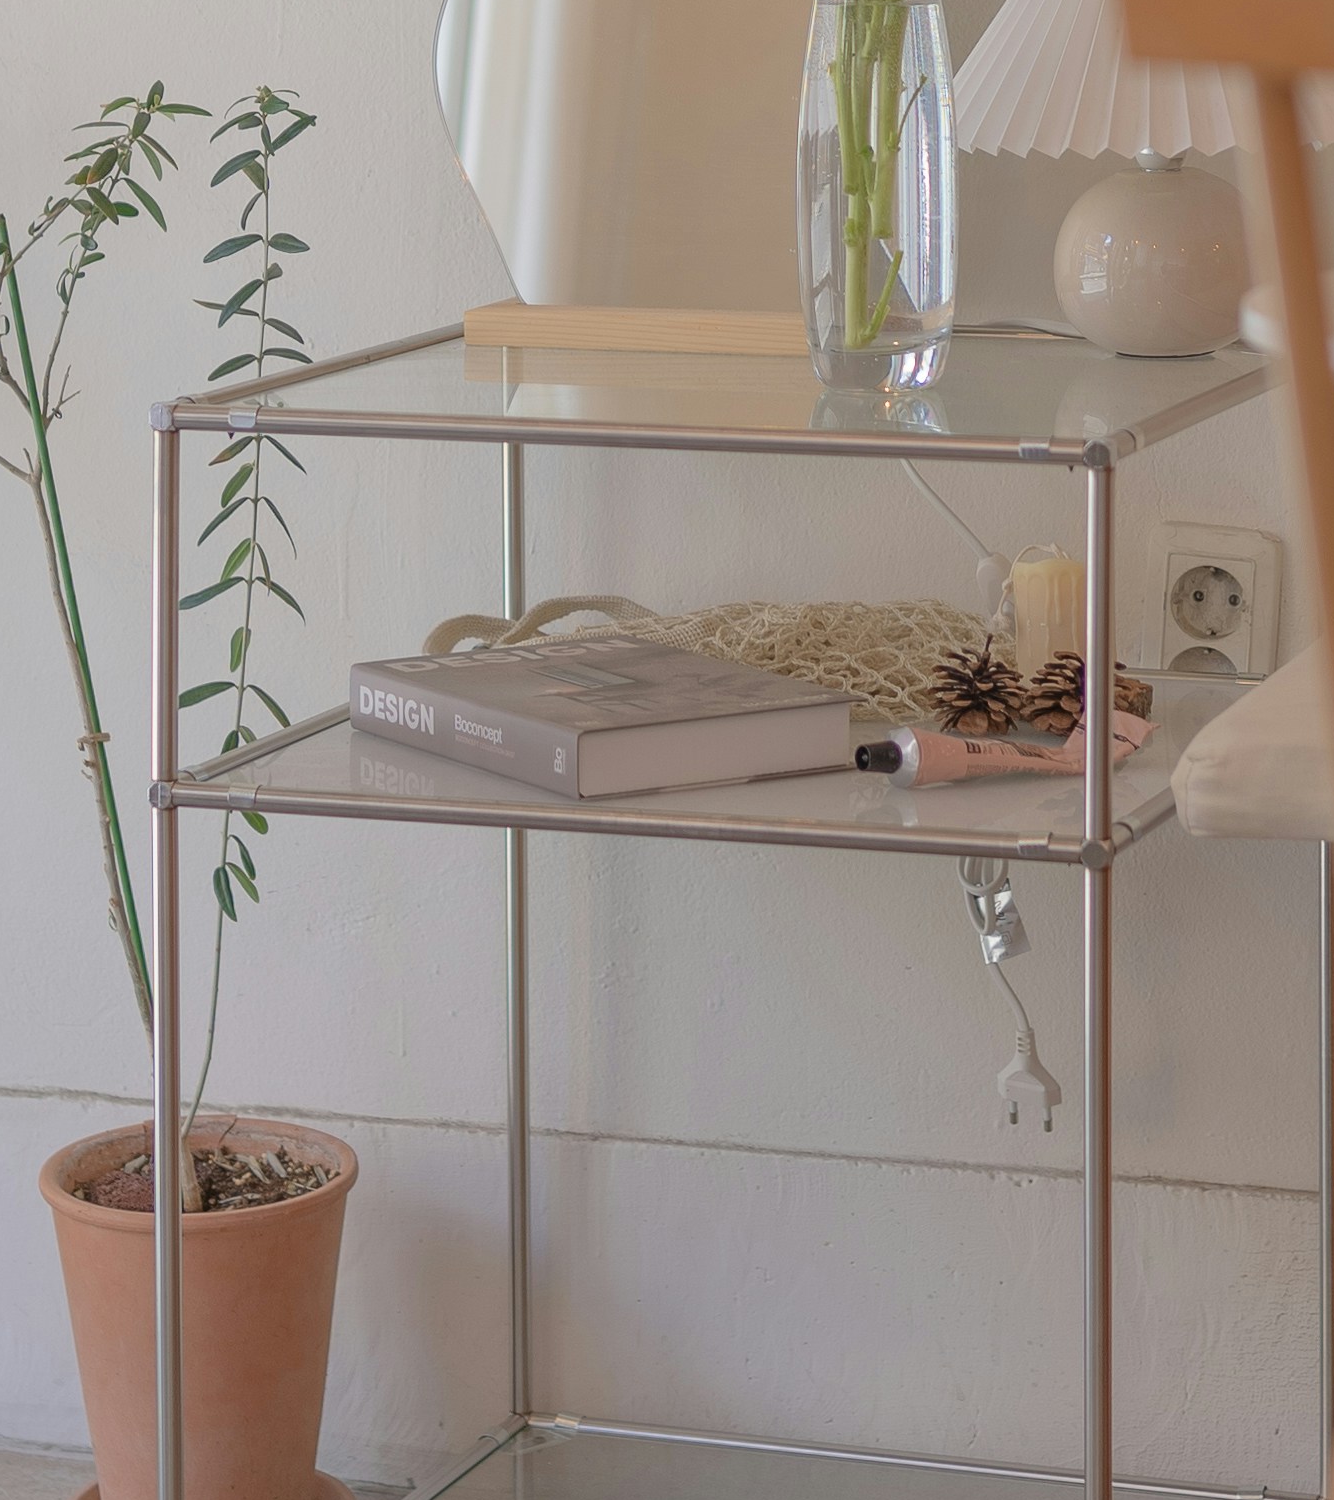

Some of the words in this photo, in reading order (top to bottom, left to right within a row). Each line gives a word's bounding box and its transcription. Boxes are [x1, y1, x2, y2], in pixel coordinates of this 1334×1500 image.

[384, 639, 641, 673] DESIGN
[359, 685, 435, 736] DESIGN
[454, 714, 503, 744] Boconcept
